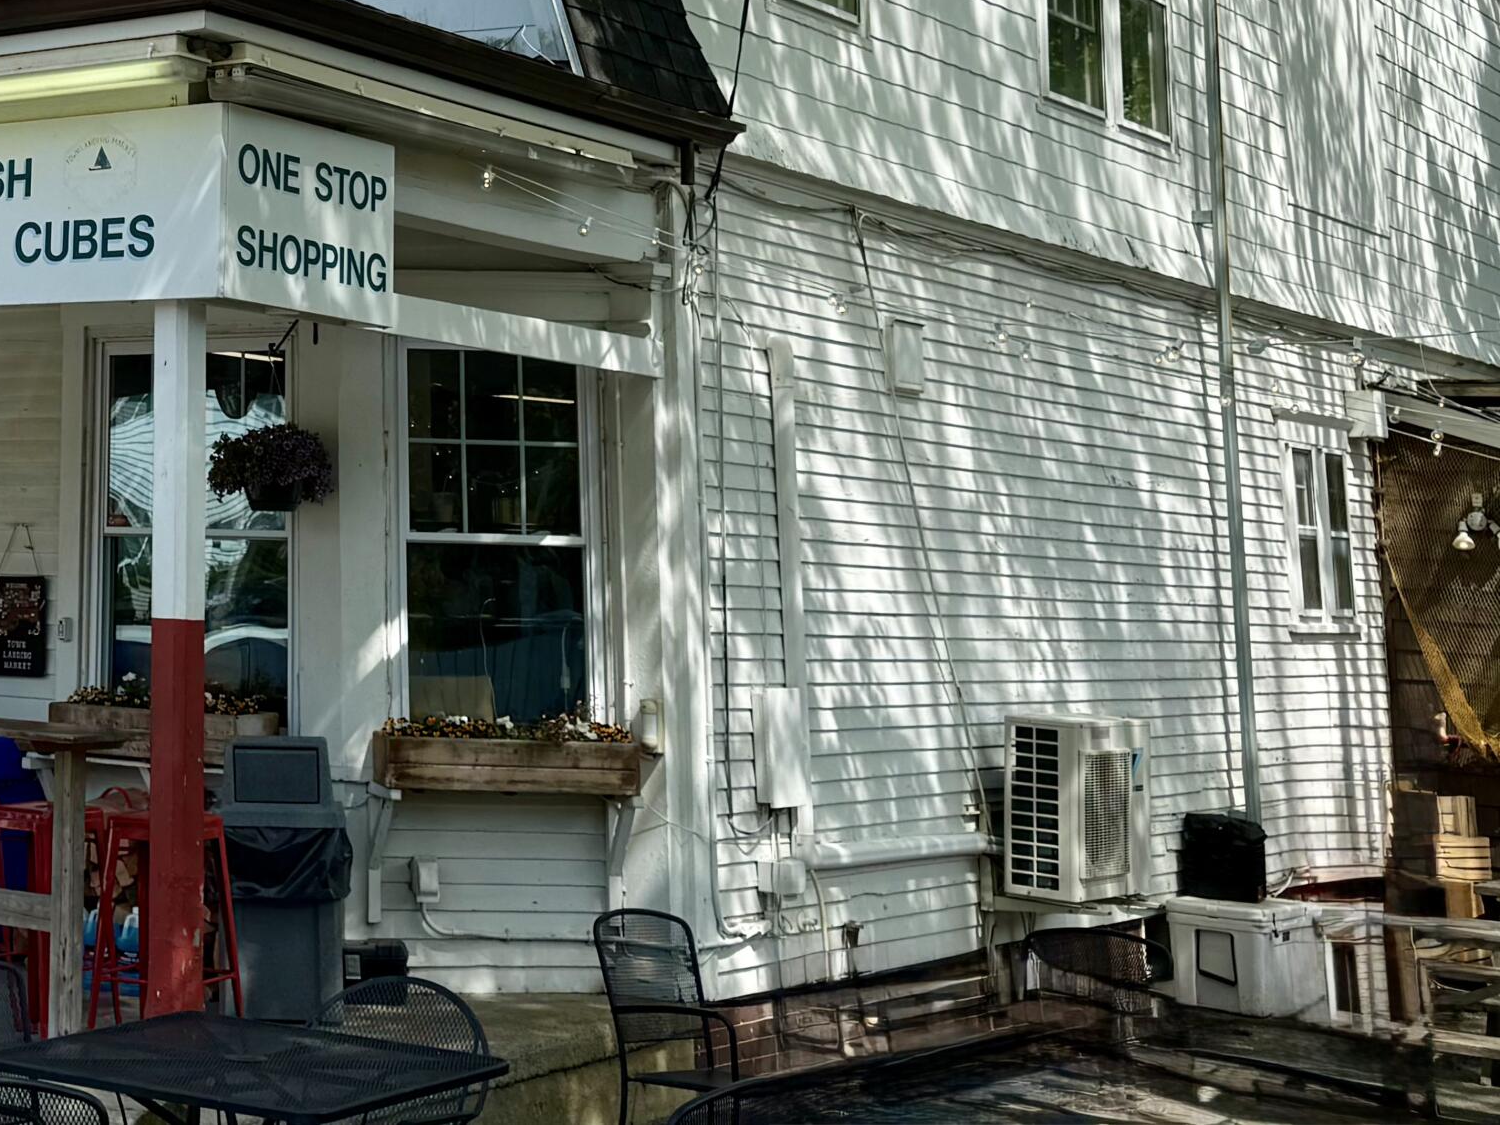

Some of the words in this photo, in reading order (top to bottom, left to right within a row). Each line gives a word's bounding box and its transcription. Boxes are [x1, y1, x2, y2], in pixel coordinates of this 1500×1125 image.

[238, 143, 301, 195] ONE
[314, 162, 388, 212] STOP
[14, 214, 156, 264] CUBES
[236, 225, 387, 293] SHOPPING
